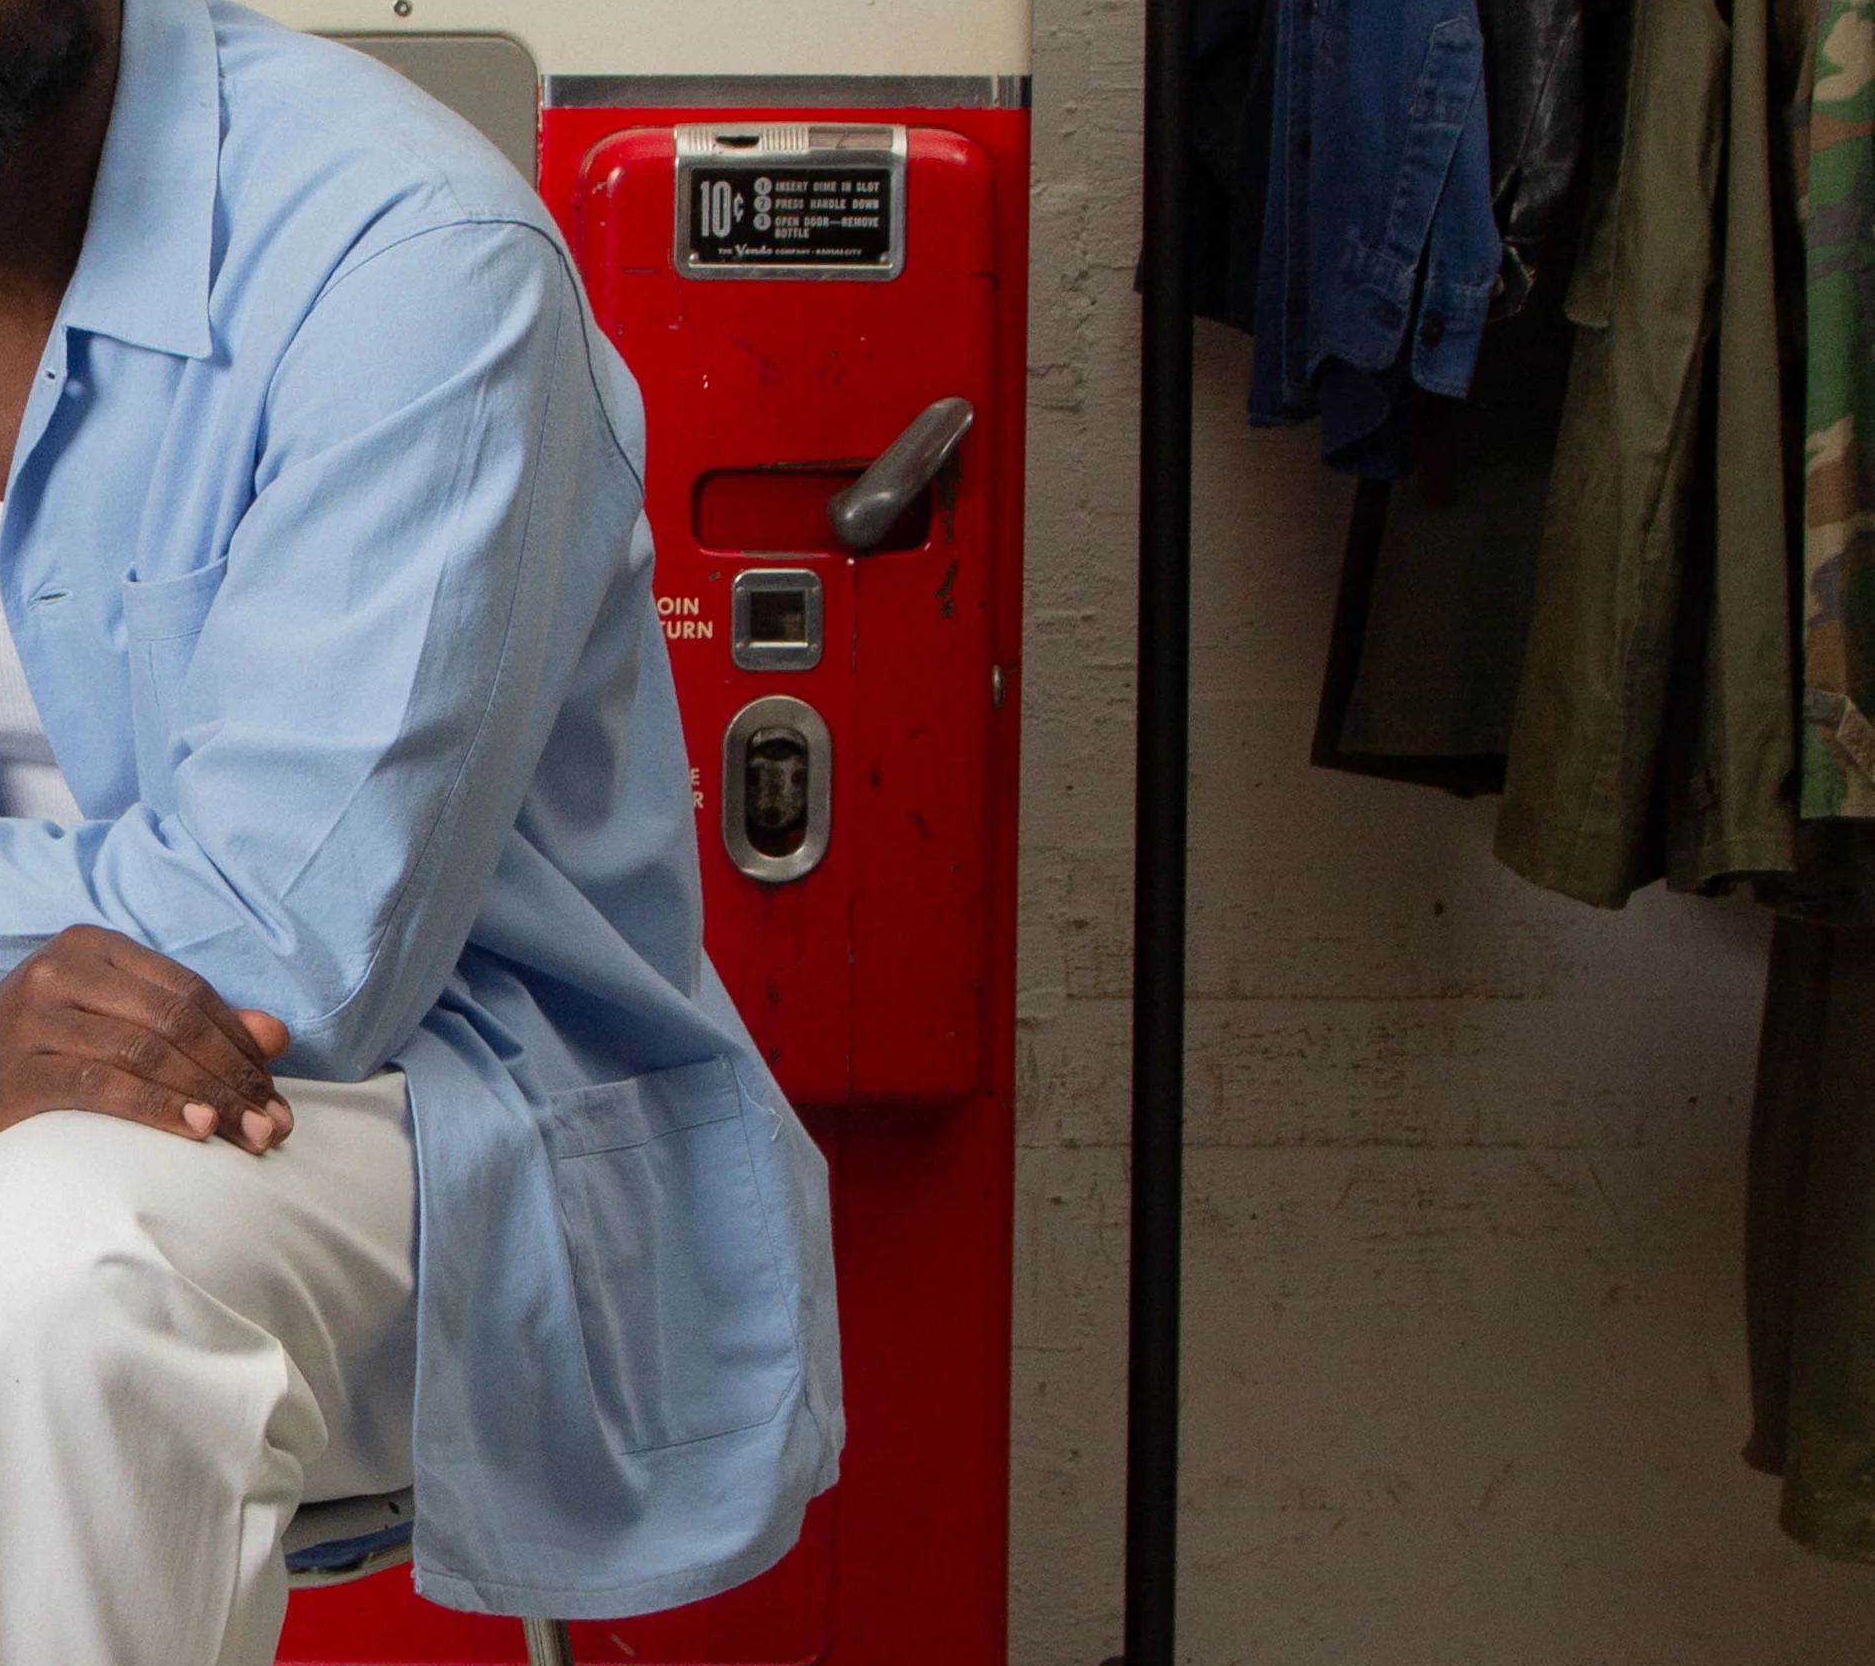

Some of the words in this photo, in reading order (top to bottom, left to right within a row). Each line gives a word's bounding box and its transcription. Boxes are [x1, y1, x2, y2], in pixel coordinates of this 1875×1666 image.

[775, 181, 809, 193] INSERT
[812, 181, 837, 193] DIME
[841, 181, 852, 193] IN
[856, 181, 881, 193] SLOT
[775, 198, 805, 210] PRESS
[809, 198, 847, 210] HANDLE
[852, 198, 880, 210] DOWN
[774, 215, 800, 227] OPEN
[774, 227, 811, 239] BOTTLE
[657, 596, 700, 615] OIN
[660, 620, 714, 639] URN
